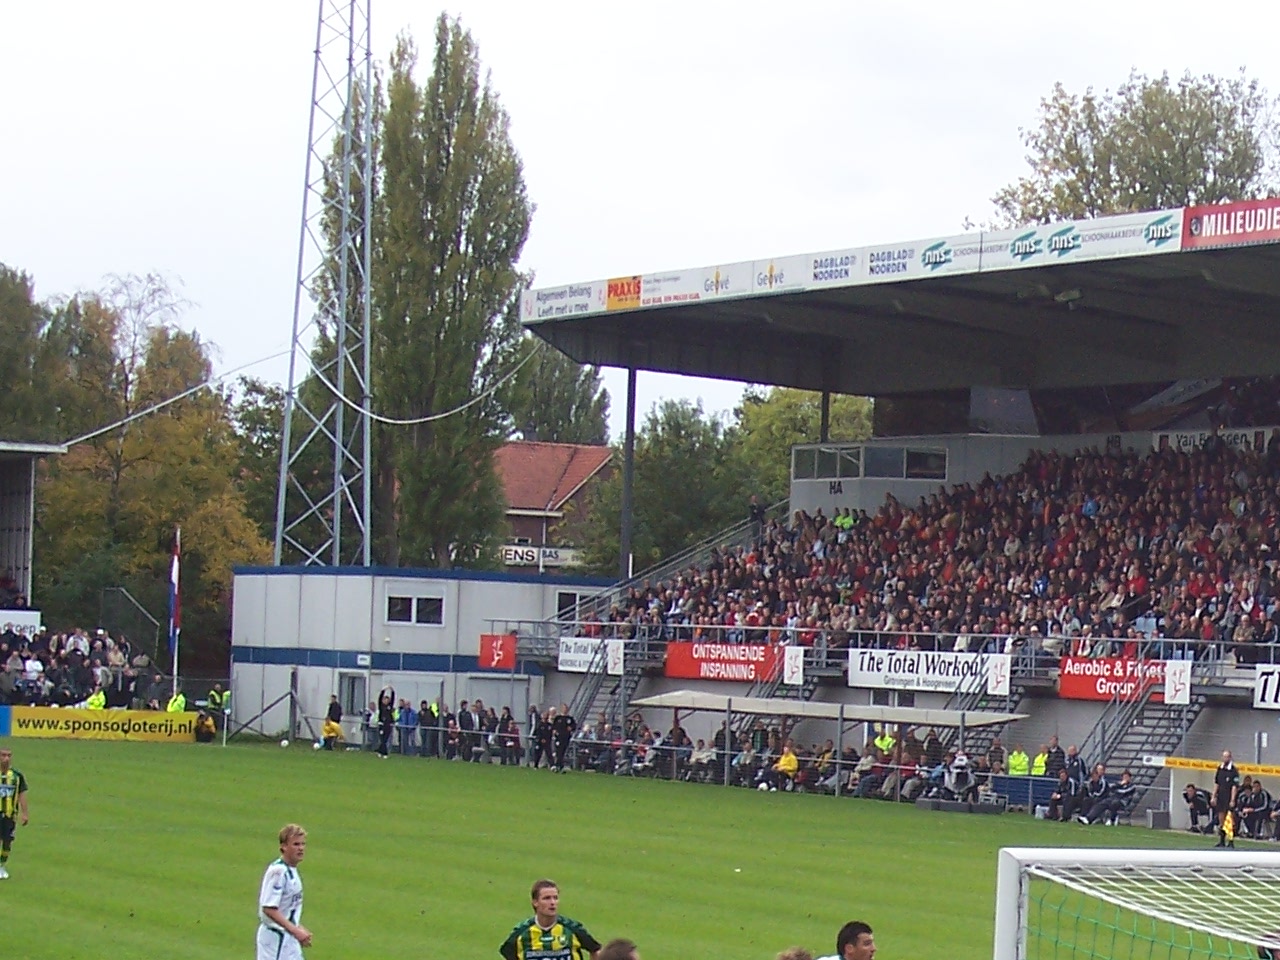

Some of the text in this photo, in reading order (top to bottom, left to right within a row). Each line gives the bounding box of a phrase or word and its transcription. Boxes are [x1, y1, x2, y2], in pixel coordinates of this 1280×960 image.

[1051, 233, 1075, 250] nns
[1149, 224, 1172, 240] nns
[868, 250, 908, 263] DAGBLAD
[925, 250, 946, 264] nns
[1015, 240, 1036, 254] nns
[813, 258, 850, 270] DAGBLAD
[868, 261, 907, 275] NOORDEN
[813, 268, 849, 281] NOORDEN
[569, 286, 592, 299] Belang
[607, 280, 641, 298] PRAXIS
[829, 481, 843, 495] HA
[692, 643, 765, 661] ONTSPANNENDE
[700, 662, 755, 679] INSPANNING
[859, 651, 883, 672] The
[887, 652, 921, 675] Total
[1064, 658, 1110, 676] Aerobic
[1113, 660, 1124, 677] &
[1096, 678, 1135, 694] Group
[17, 716, 192, 738] www.sponsorloterij.nl
